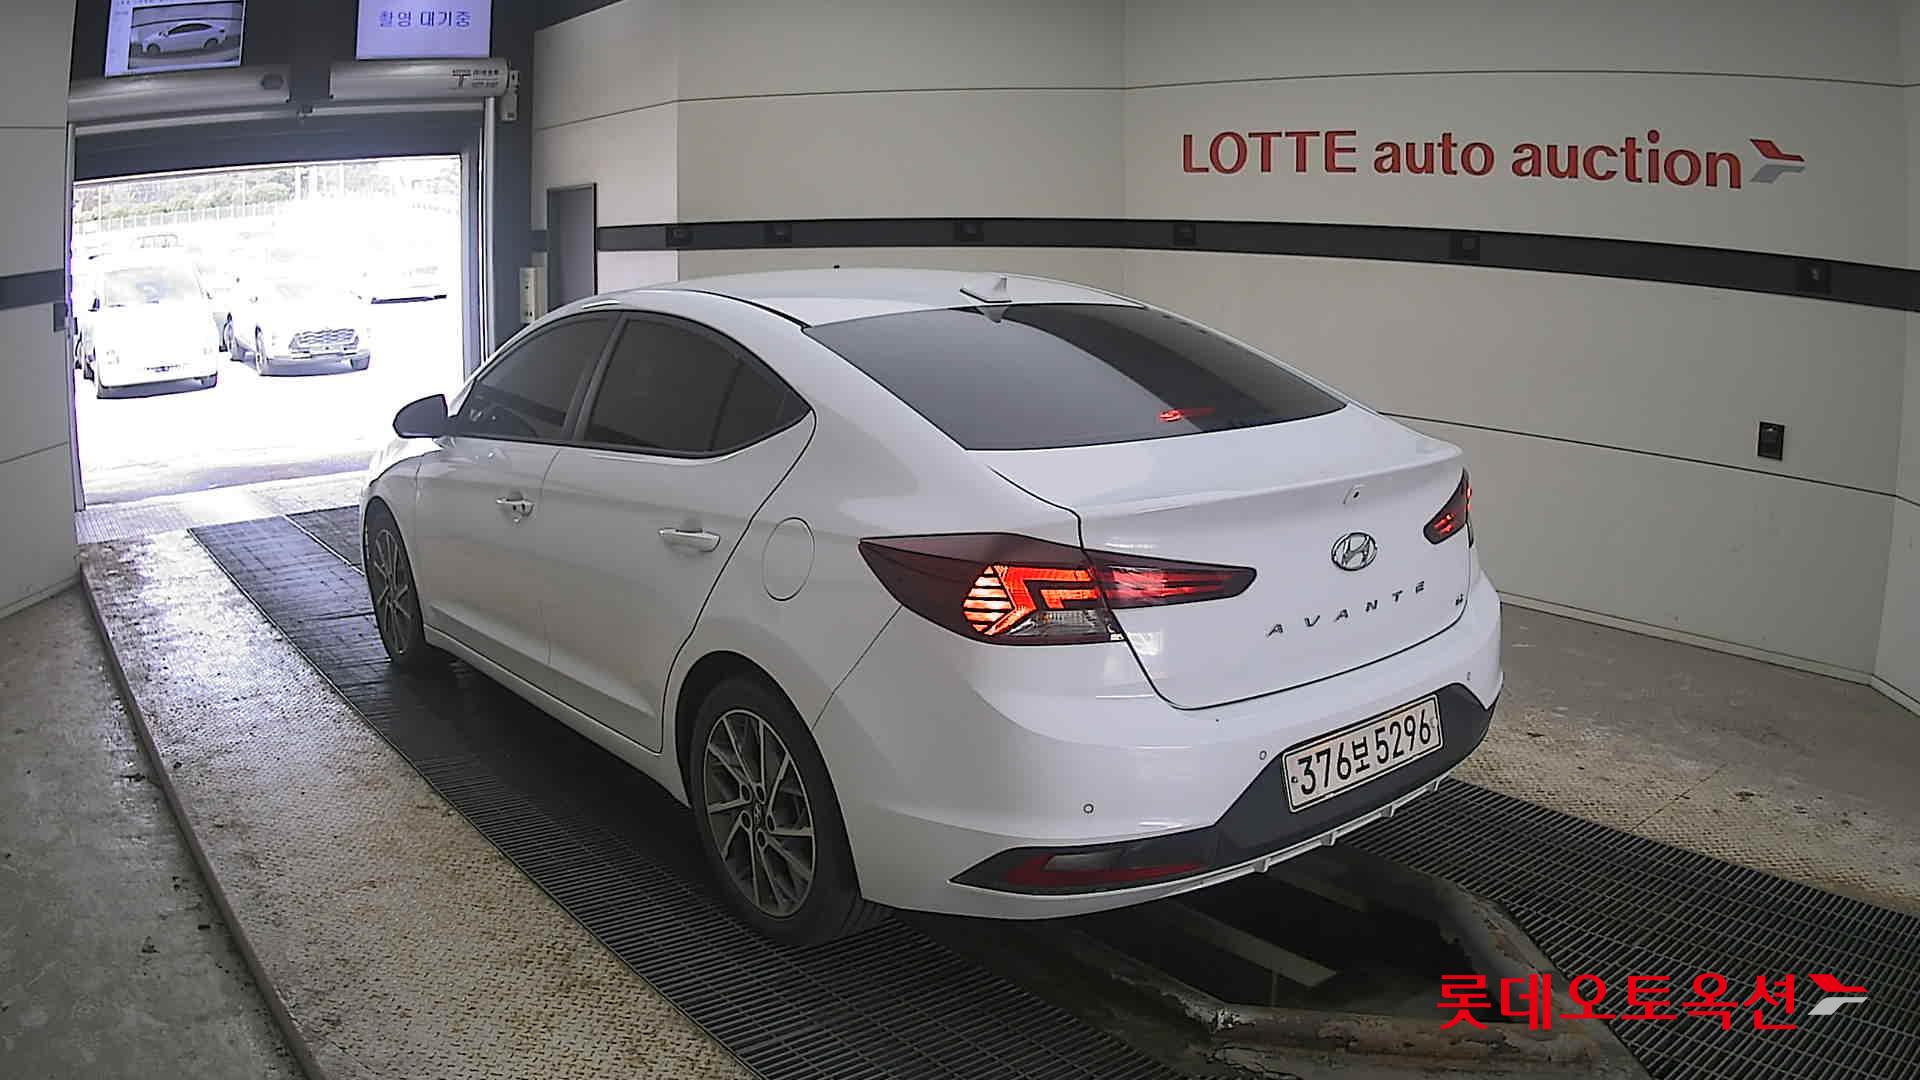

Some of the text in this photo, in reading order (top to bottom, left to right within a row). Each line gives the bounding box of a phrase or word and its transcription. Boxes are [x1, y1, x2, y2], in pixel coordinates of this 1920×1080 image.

[420, 10, 471, 27] 대기중
[1183, 129, 1742, 189] LOTTE auto auction
[1266, 580, 1426, 638] AVANTE
